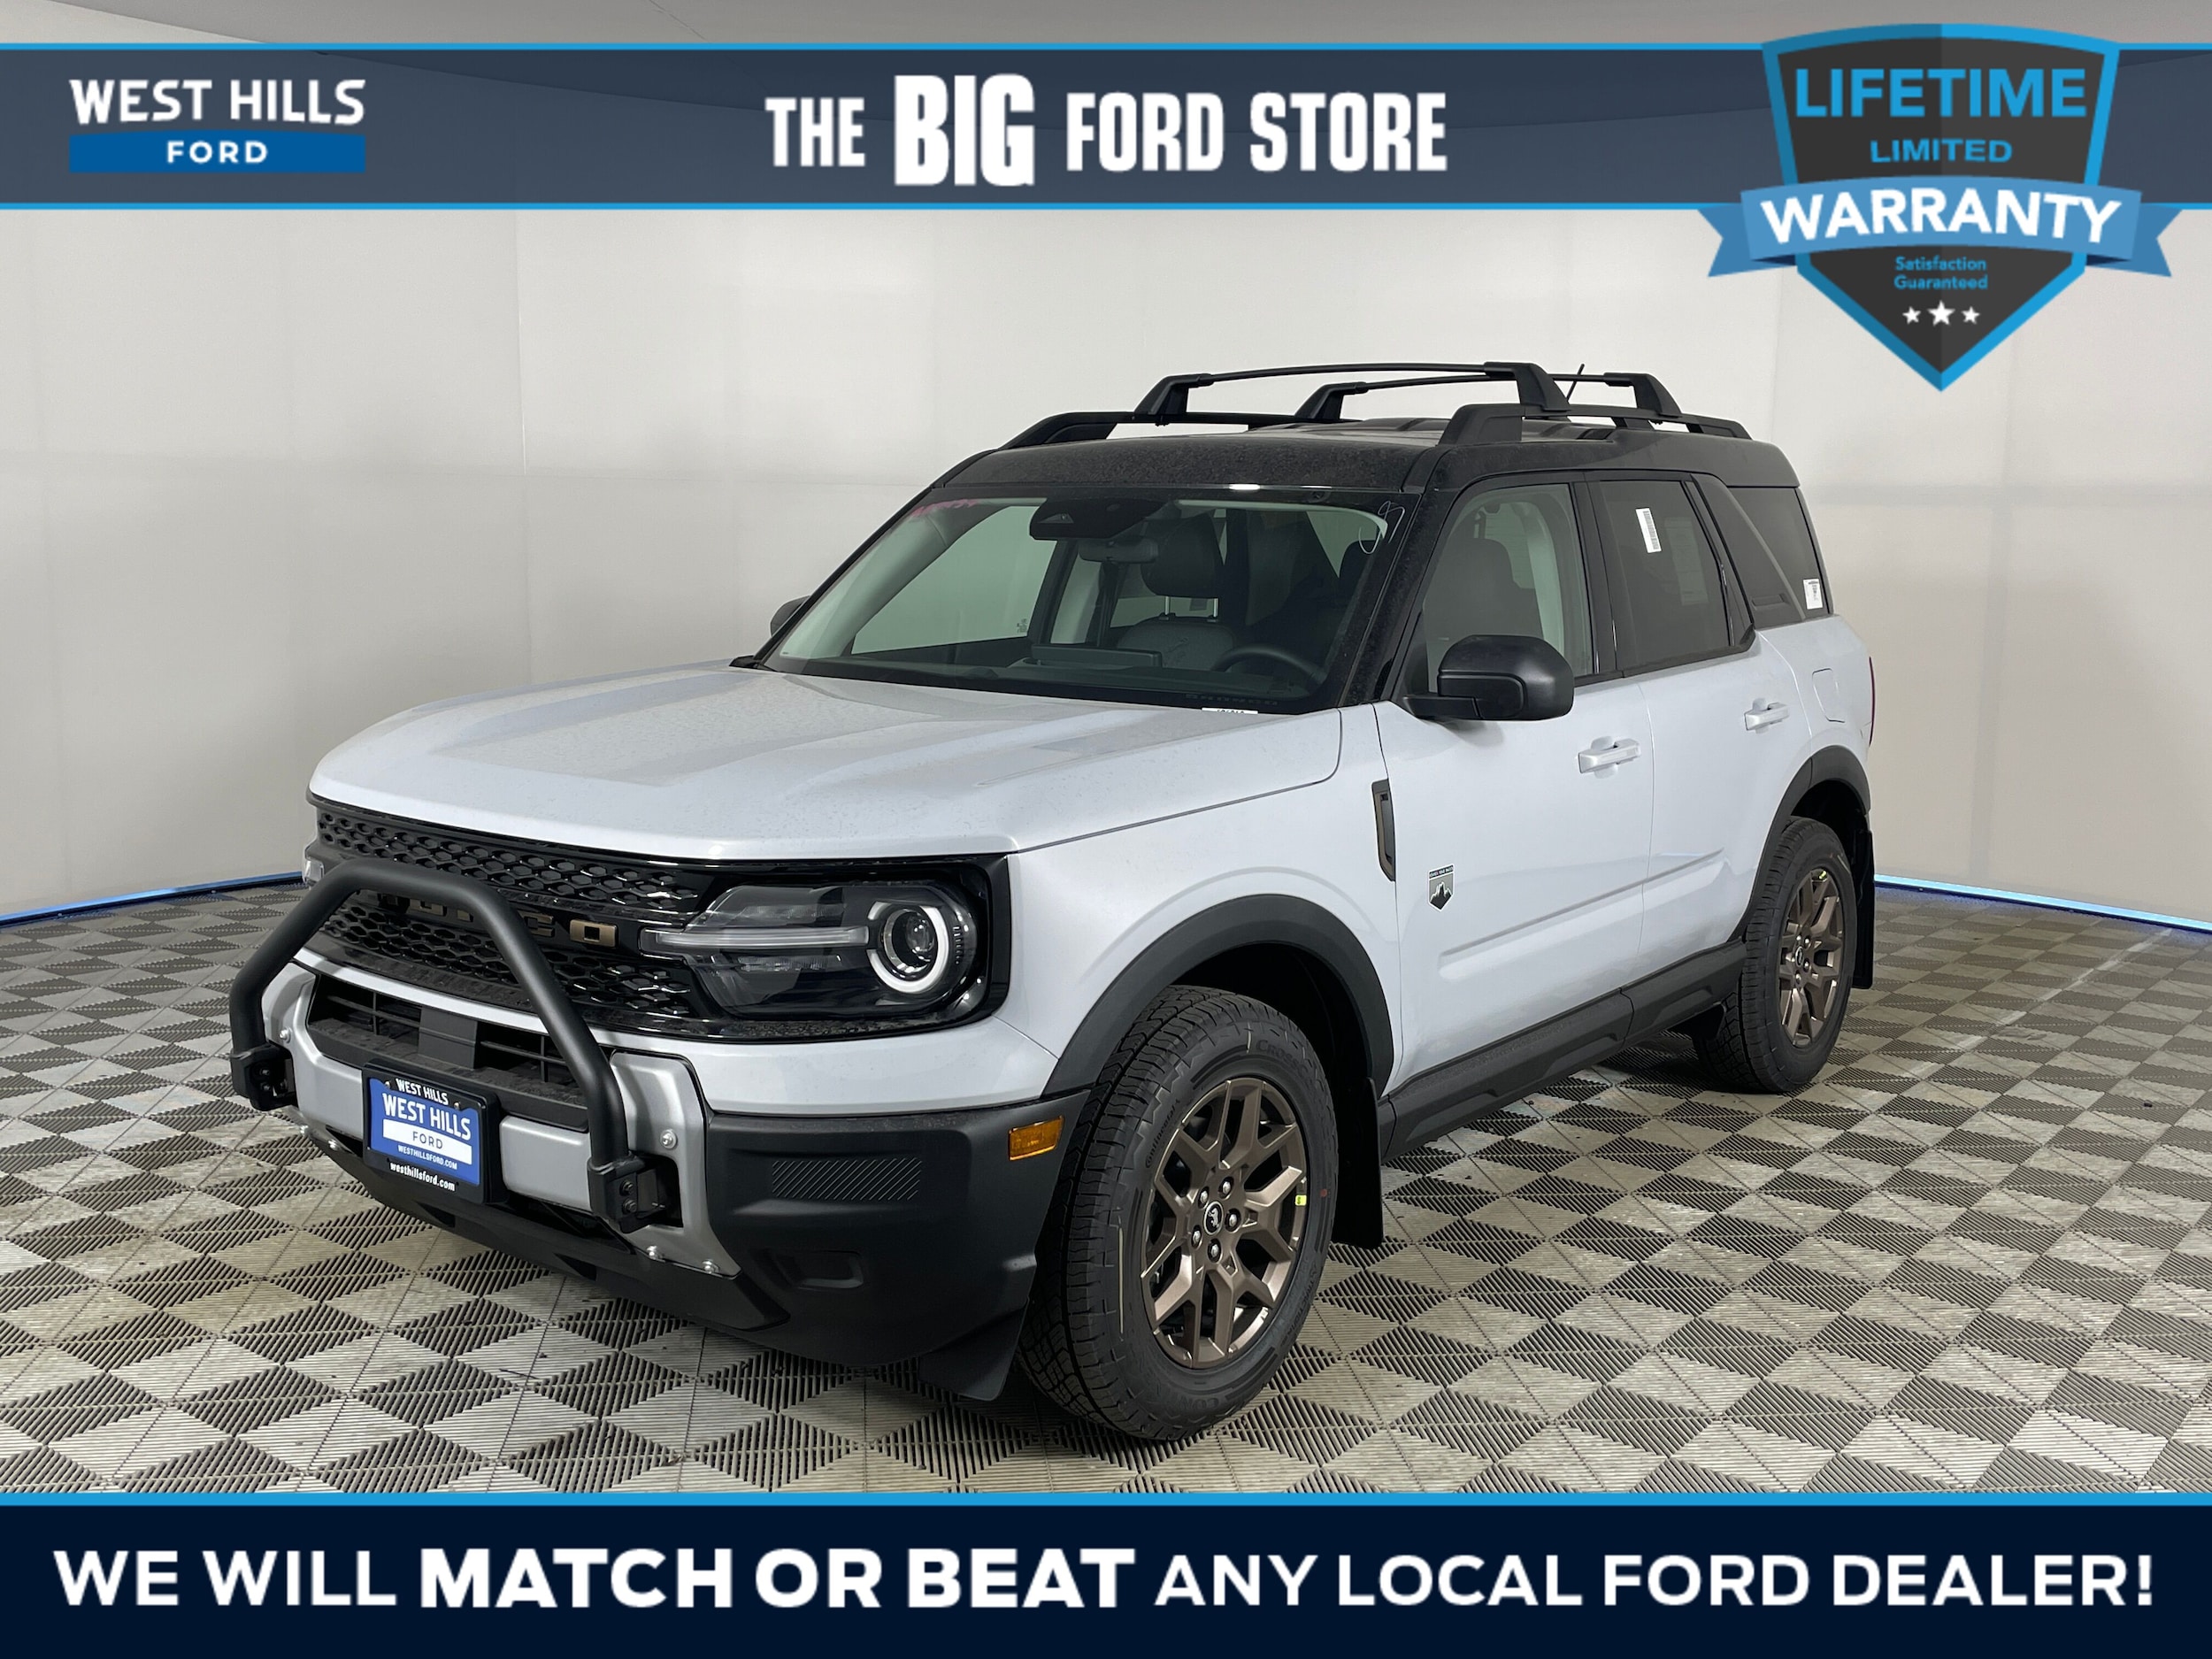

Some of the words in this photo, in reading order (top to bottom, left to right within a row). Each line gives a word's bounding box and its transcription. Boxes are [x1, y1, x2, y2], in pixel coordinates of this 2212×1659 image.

[396, 1078, 422, 1096] WEST
[424, 1087, 449, 1106] HILLS
[382, 1093, 426, 1125] WEST
[430, 1107, 471, 1141] HILLS
[412, 1131, 444, 1150] FORD
[397, 1144, 458, 1171] WESTHILLSFORD.COM
[390, 1162, 456, 1191] westhillsford.com
